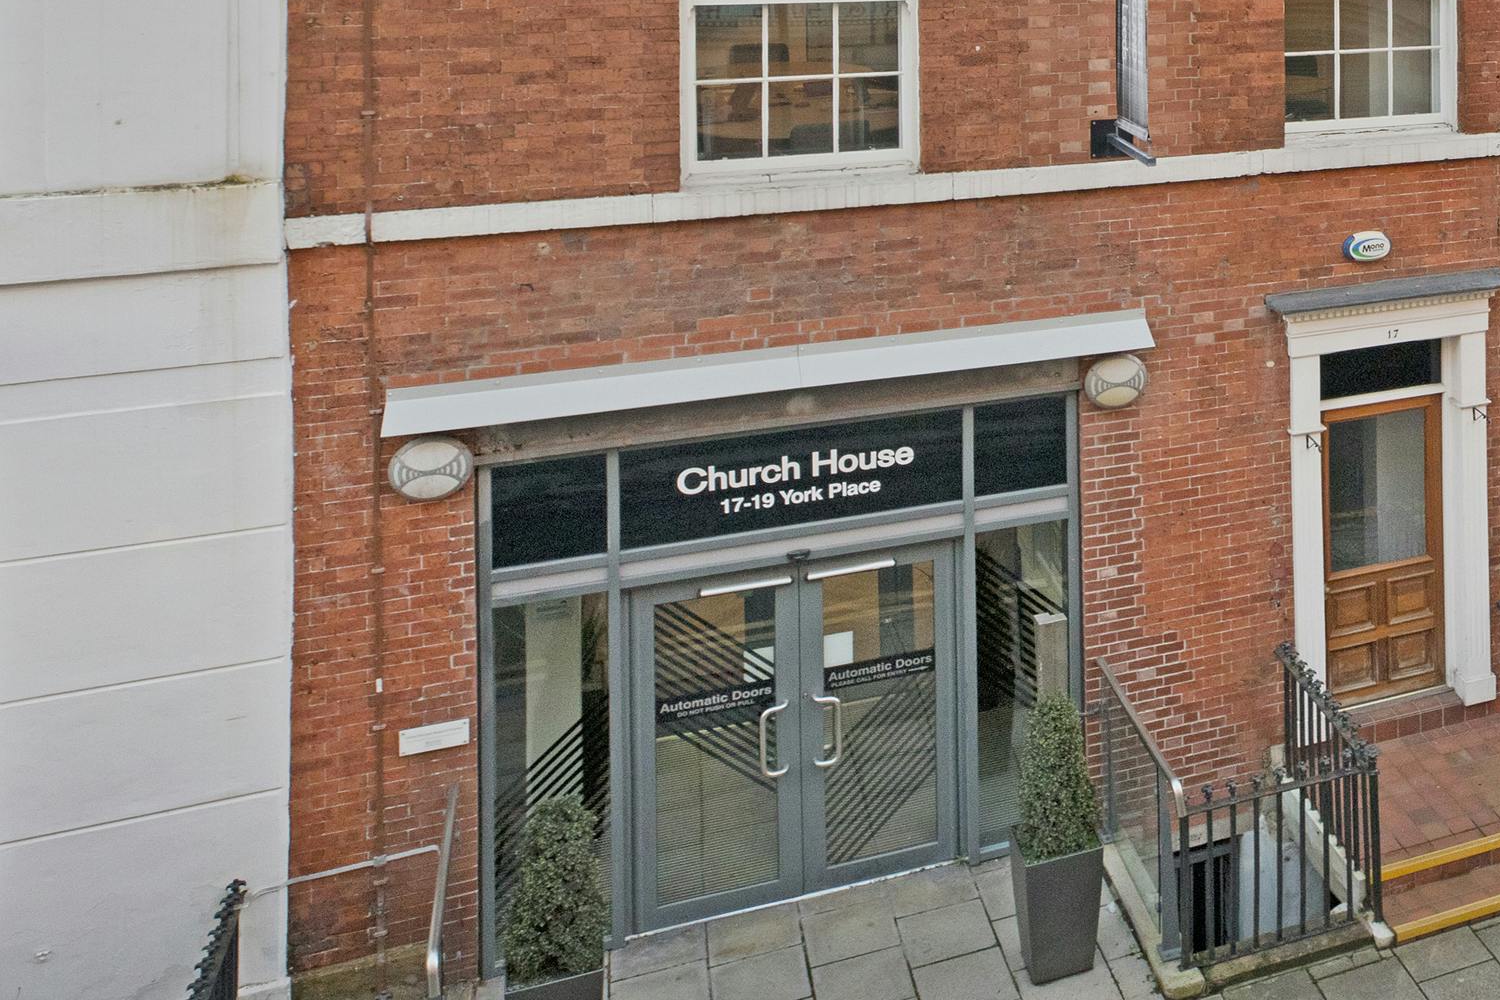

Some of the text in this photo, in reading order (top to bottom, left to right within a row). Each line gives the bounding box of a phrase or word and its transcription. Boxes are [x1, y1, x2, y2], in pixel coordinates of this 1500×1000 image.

[1387, 328, 1399, 340] 17
[676, 446, 915, 495] Church House
[720, 479, 882, 514] 17-19 York Place
[829, 655, 933, 682] Automatic Doors
[659, 686, 773, 714] Automatic Doors
[689, 708, 704, 716] NOT
